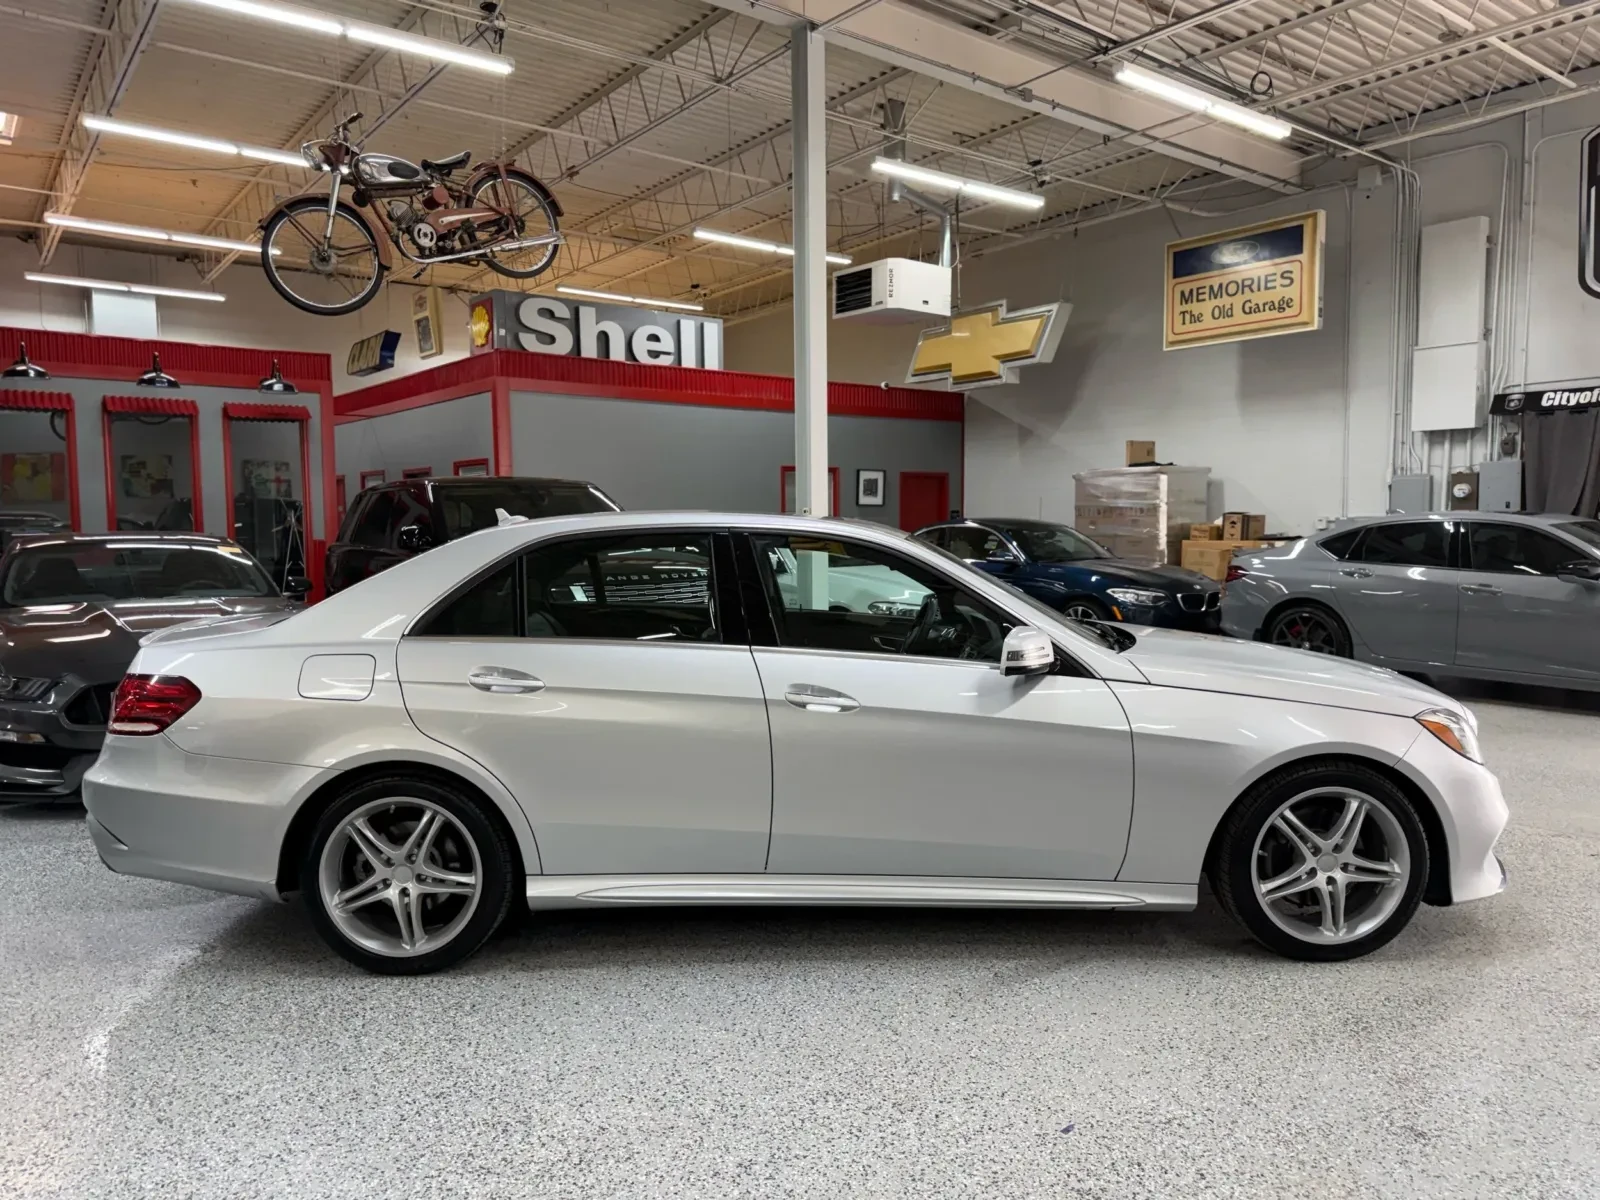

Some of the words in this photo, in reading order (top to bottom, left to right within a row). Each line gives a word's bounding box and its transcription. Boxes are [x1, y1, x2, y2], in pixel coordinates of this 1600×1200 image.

[1179, 270, 1295, 306] MEMORIES
[1179, 310, 1204, 326] The
[1211, 303, 1234, 320] Old
[1241, 296, 1294, 316] Garage
[518, 297, 719, 370] Shell
[1541, 388, 1600, 407] Cityof
